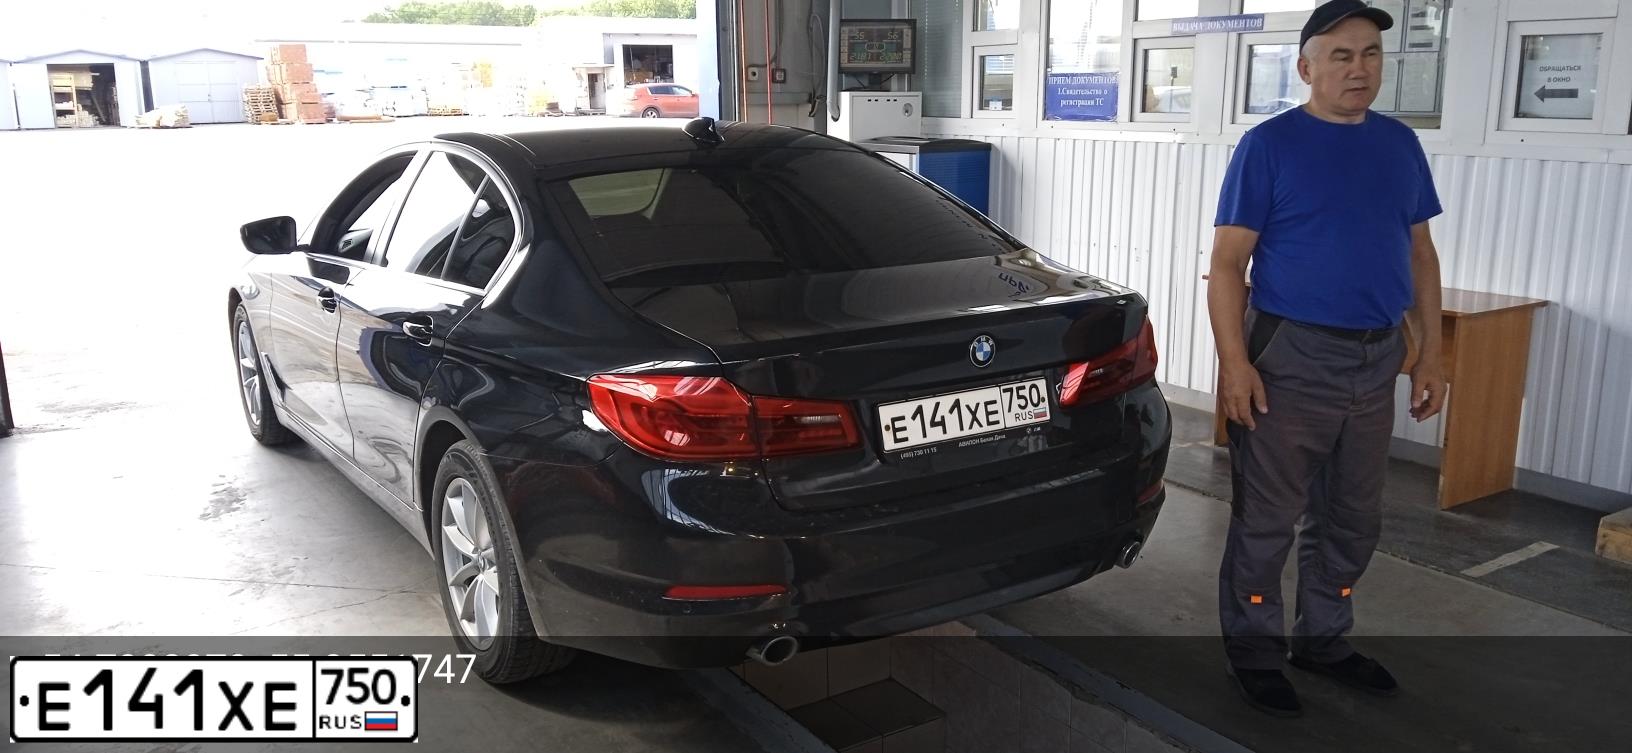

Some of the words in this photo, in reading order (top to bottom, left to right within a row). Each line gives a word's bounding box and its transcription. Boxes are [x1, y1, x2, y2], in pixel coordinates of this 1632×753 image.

[1172, 22, 1203, 32] ВЫДАЧА
[1207, 18, 1263, 30] ДОКУМЕНТОВ
[1048, 76, 1071, 85] ПРИЕМ
[1095, 97, 1105, 106] ТС
[1002, 383, 1042, 413] 750
[1014, 410, 1034, 423] RUS
